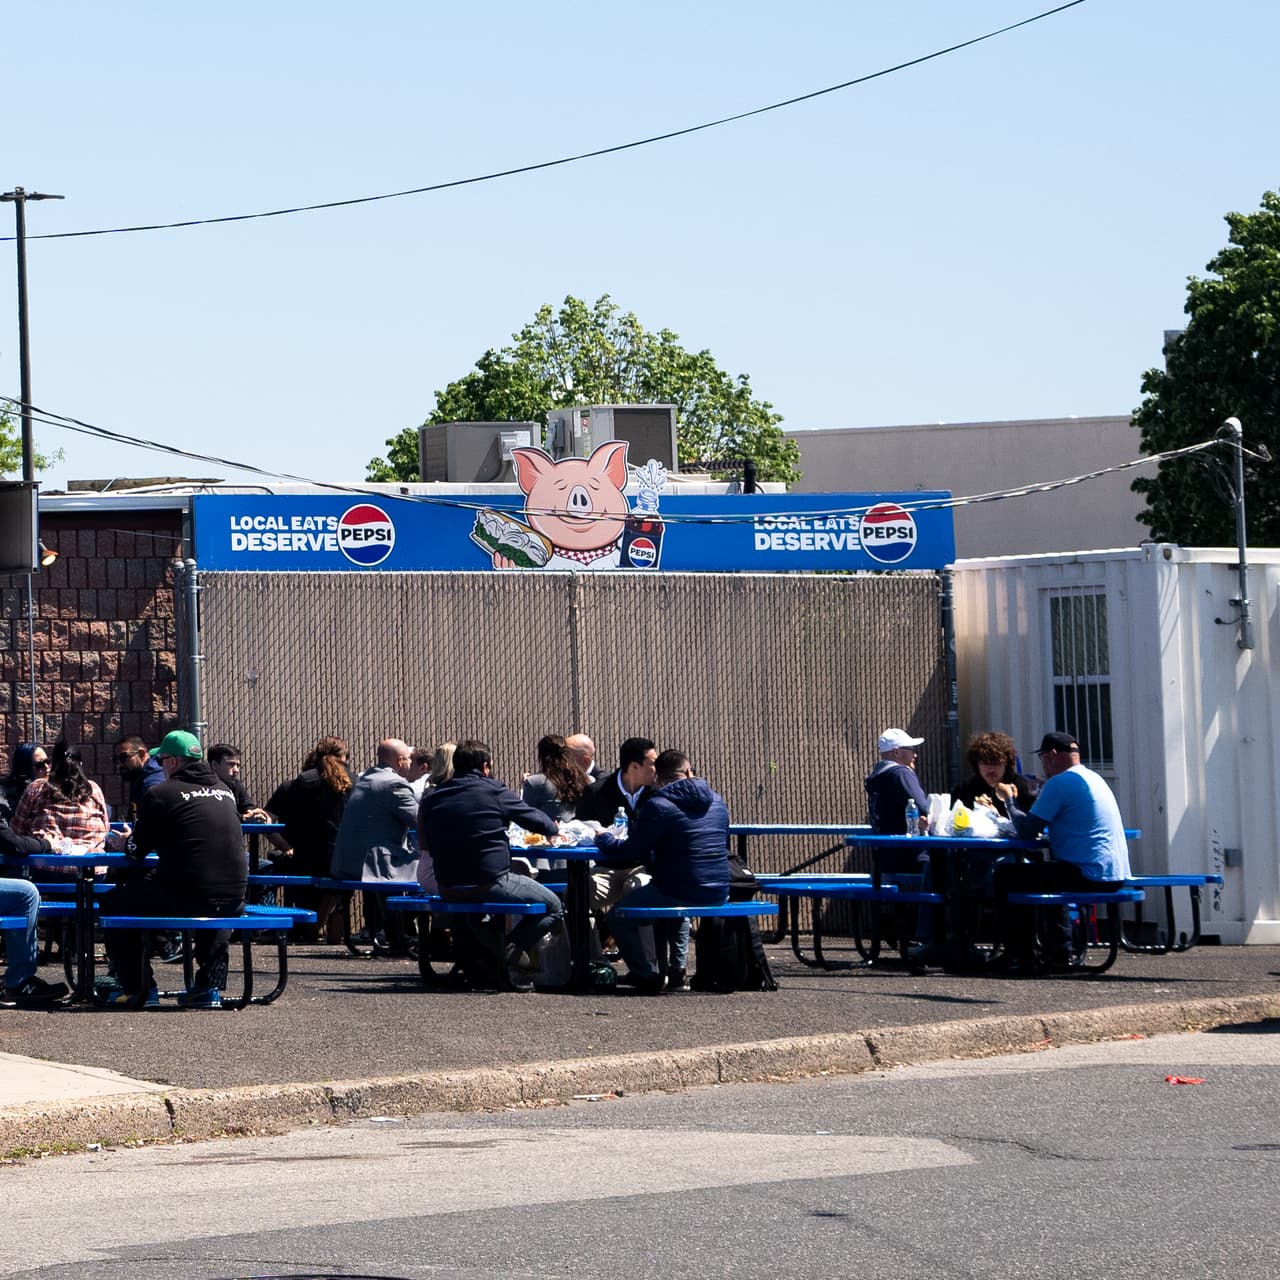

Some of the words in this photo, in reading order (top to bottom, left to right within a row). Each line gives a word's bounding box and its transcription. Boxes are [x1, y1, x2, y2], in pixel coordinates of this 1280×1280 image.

[230, 516, 288, 531] LOCAL
[291, 516, 339, 531] EATS
[753, 516, 811, 530] LOCAL
[813, 516, 860, 530] EATS
[340, 528, 392, 542] PEPSI
[863, 526, 914, 540] PEPSI
[231, 532, 339, 552] DESERVE
[754, 532, 862, 551] DESERVE
[630, 547, 655, 559] PEPSI
